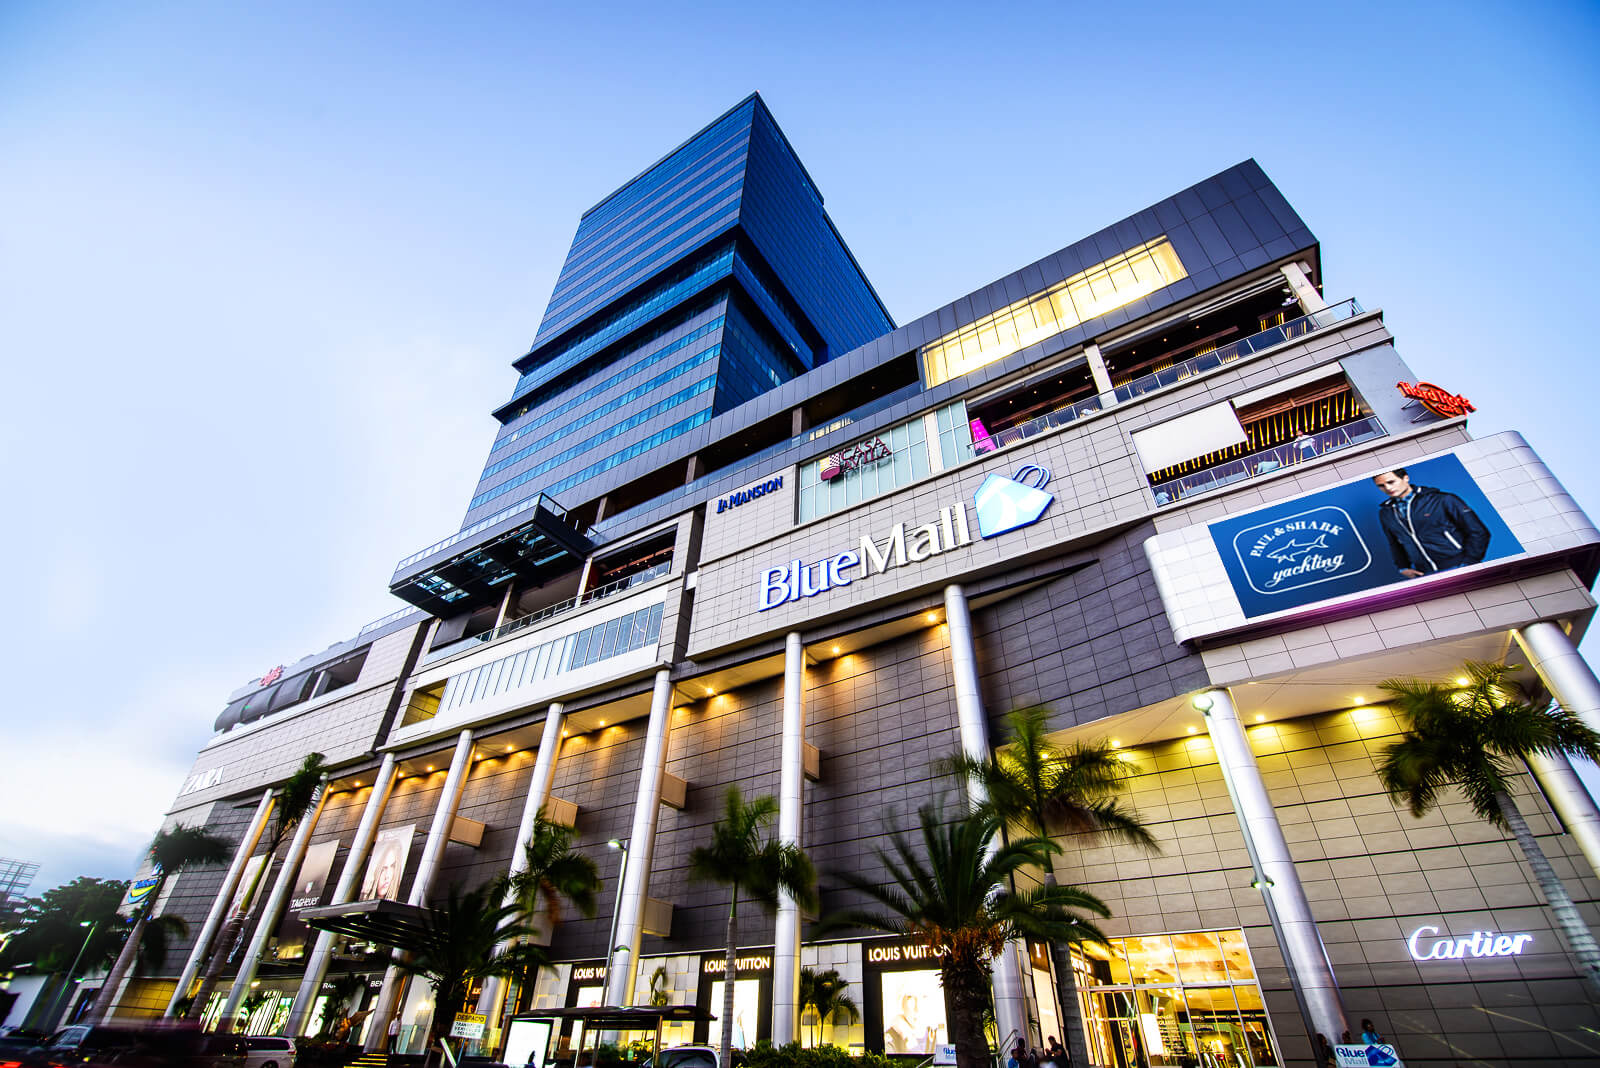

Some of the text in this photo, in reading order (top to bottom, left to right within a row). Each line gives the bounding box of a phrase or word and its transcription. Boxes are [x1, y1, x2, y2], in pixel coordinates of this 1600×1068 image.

[841, 437, 886, 461] CASA
[728, 476, 783, 509] MANSION
[1264, 554, 1345, 588] yachting
[868, 945, 901, 962] LOUIS
[1408, 926, 1533, 960] Cartier
[573, 967, 595, 980] LOUIS
[735, 956, 770, 971] UITTON
